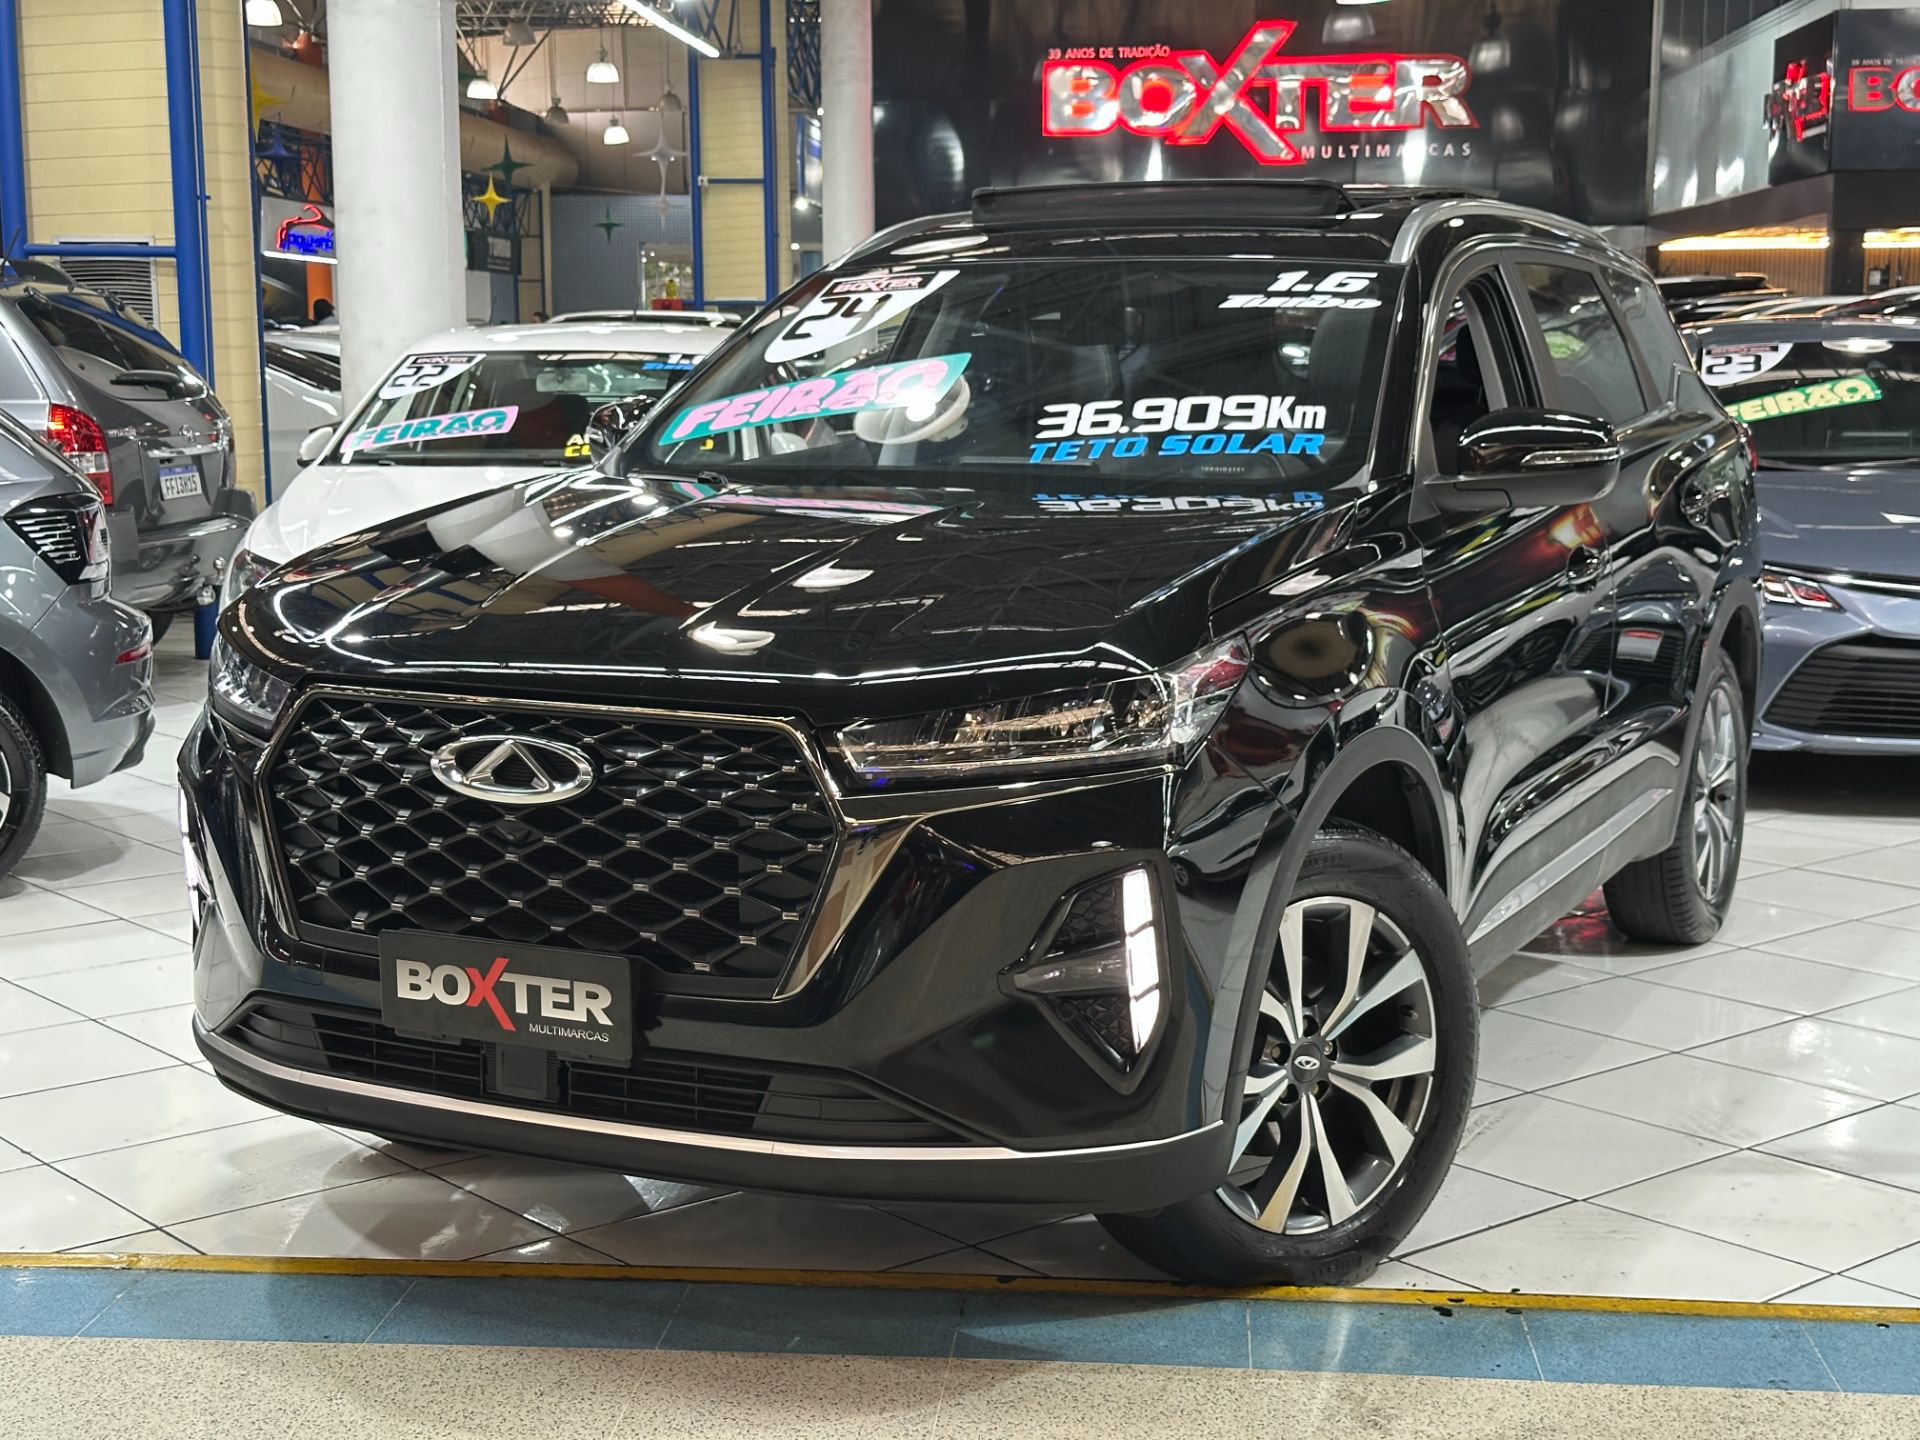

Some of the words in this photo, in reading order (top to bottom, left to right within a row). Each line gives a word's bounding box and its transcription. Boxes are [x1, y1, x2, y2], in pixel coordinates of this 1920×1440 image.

[1048, 48, 1061, 59] 39
[1065, 48, 1095, 59] ANOS
[1099, 47, 1113, 59] DE
[1117, 44, 1171, 59] TRADIÇÃO
[1042, 21, 1480, 165] BOXTER
[1301, 142, 1471, 159] MULTIMACAS
[832, 276, 923, 293] BOXTER
[1267, 270, 1378, 293] 1.6
[782, 293, 893, 341] 24
[389, 365, 450, 388] 22
[1706, 354, 1762, 375] 23
[672, 359, 949, 439] FEIRÃO
[352, 410, 508, 446] FEIRÃO
[1035, 395, 1327, 438] 36.909Km
[1029, 437, 1149, 463] TETO
[1158, 434, 1326, 456] SOLAR
[396, 957, 614, 1032] BOXTER
[529, 1023, 609, 1042] MULTIMARCAS
